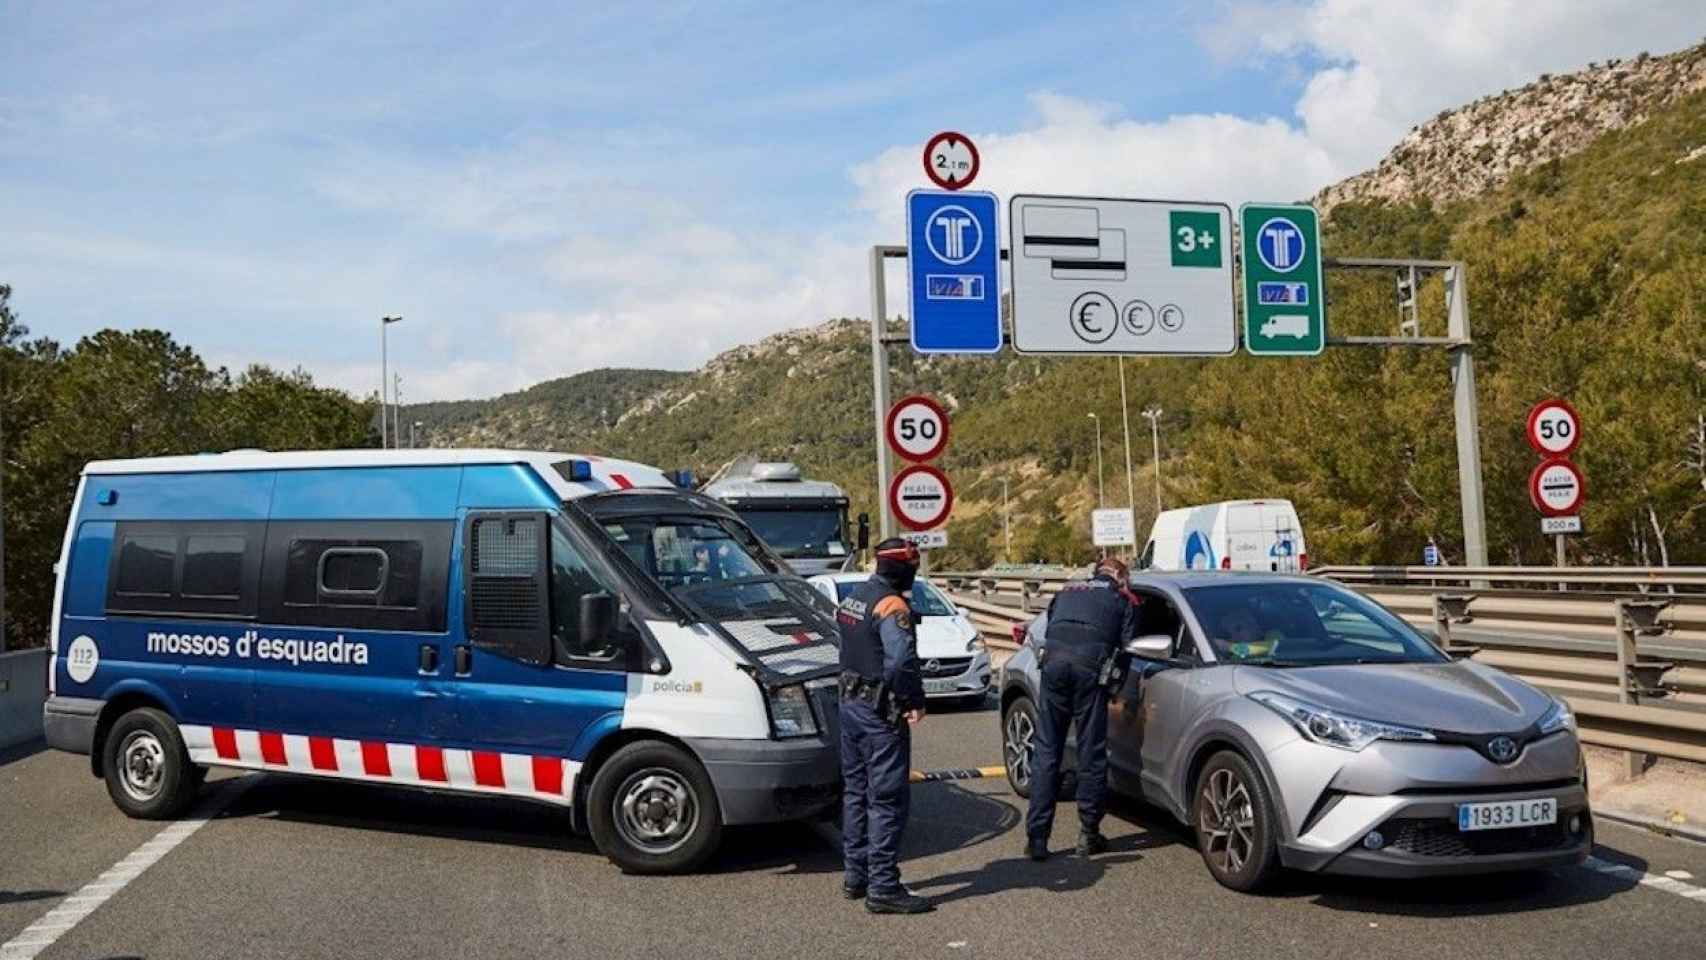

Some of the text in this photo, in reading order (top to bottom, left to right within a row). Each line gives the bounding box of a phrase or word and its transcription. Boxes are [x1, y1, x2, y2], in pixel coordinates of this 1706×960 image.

[1177, 226, 1215, 253] 3+
[901, 418, 936, 441] 50
[1541, 420, 1571, 439] 50
[74, 648, 93, 665] 112
[147, 631, 368, 666] mossos d'esquadra
[1473, 802, 1551, 826] 1933 LCR
